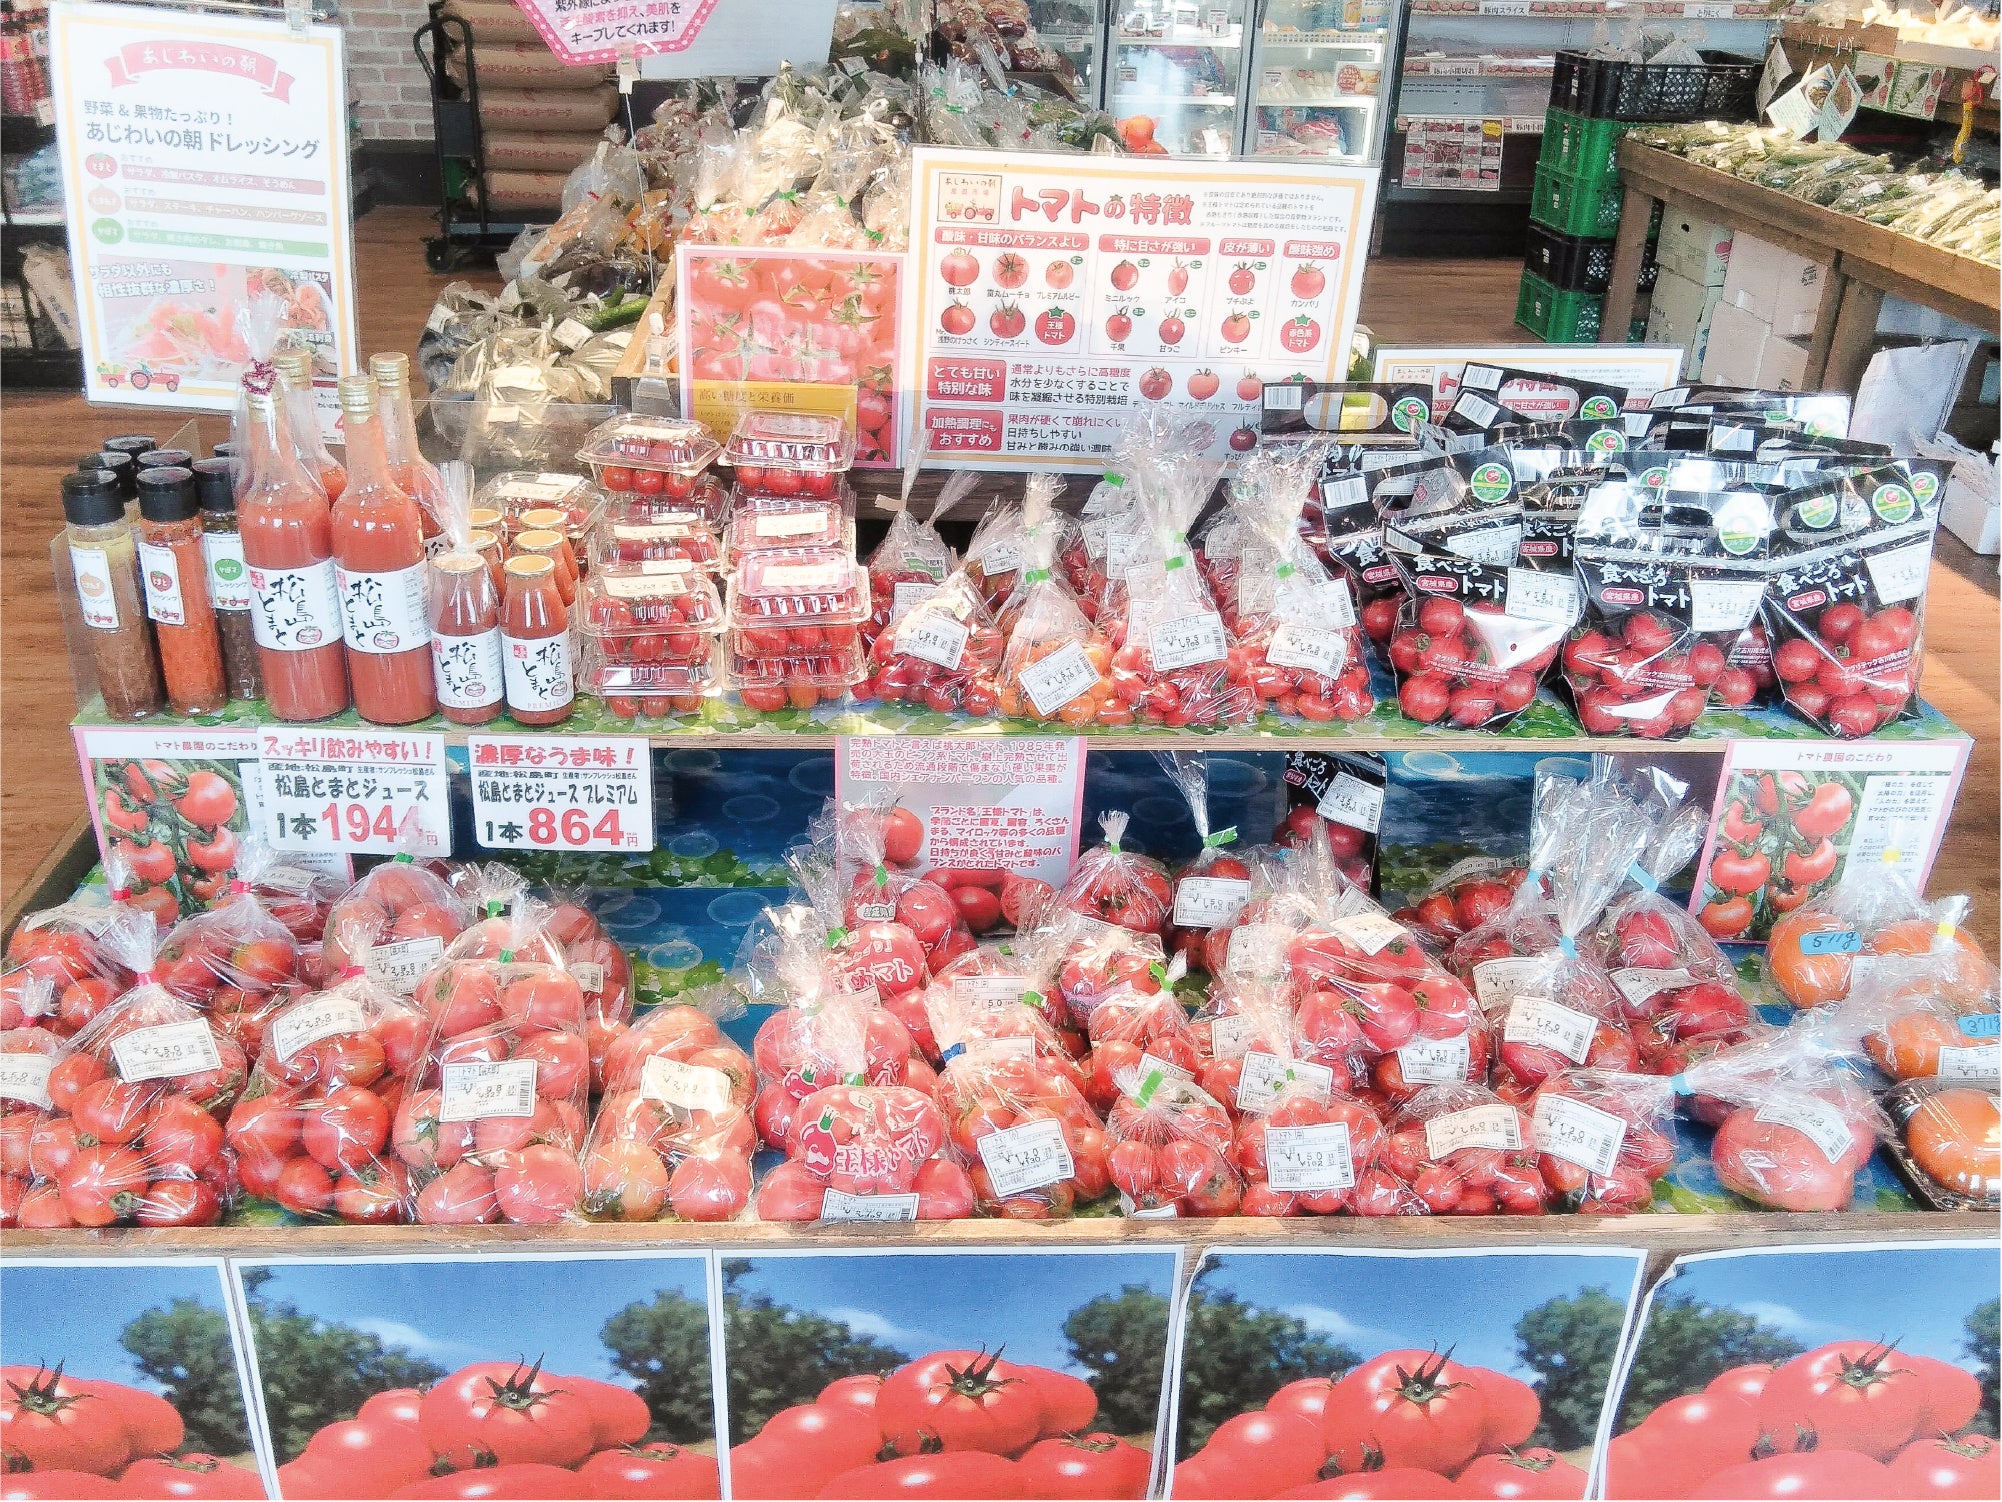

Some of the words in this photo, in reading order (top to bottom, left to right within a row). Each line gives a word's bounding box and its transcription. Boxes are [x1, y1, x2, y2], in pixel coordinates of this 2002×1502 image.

[142, 46, 257, 74] あじわいの朝
[84, 101, 114, 117] 野菜
[119, 104, 129, 118] &
[87, 122, 201, 150] あじわいの朝
[210, 131, 321, 160] ドレッシング
[1011, 185, 1194, 225] トマトの特徴
[1114, 239, 1196, 253] 特に甘さが強い
[1165, 296, 1187, 304] アイコ
[1044, 331, 1066, 340] トマト
[1288, 338, 1310, 348] トマト
[934, 366, 1000, 380] とても甘い
[938, 382, 993, 397] 特別な味
[1010, 378, 1130, 391] 水分を少なくすることで
[931, 416, 997, 432] 加熱調理にも
[1007, 428, 1082, 440] 日持ちしやすい
[939, 433, 993, 447] おすすめ
[1415, 556, 1483, 577] 食べごろ
[1600, 565, 1668, 588] 食べごろ
[1463, 575, 1505, 600] トマト
[1777, 562, 1841, 596] 食べごろ
[1827, 576, 1868, 602] トマト
[1648, 585, 1692, 609] トマト
[475, 743, 634, 767] 濃厚なうま味！
[274, 773, 430, 802] 松島とまとジュース
[478, 780, 579, 803] 松島とまとジュース
[582, 784, 638, 805] プレミアム
[529, 807, 624, 846] 864
[627, 836, 638, 847] 円
